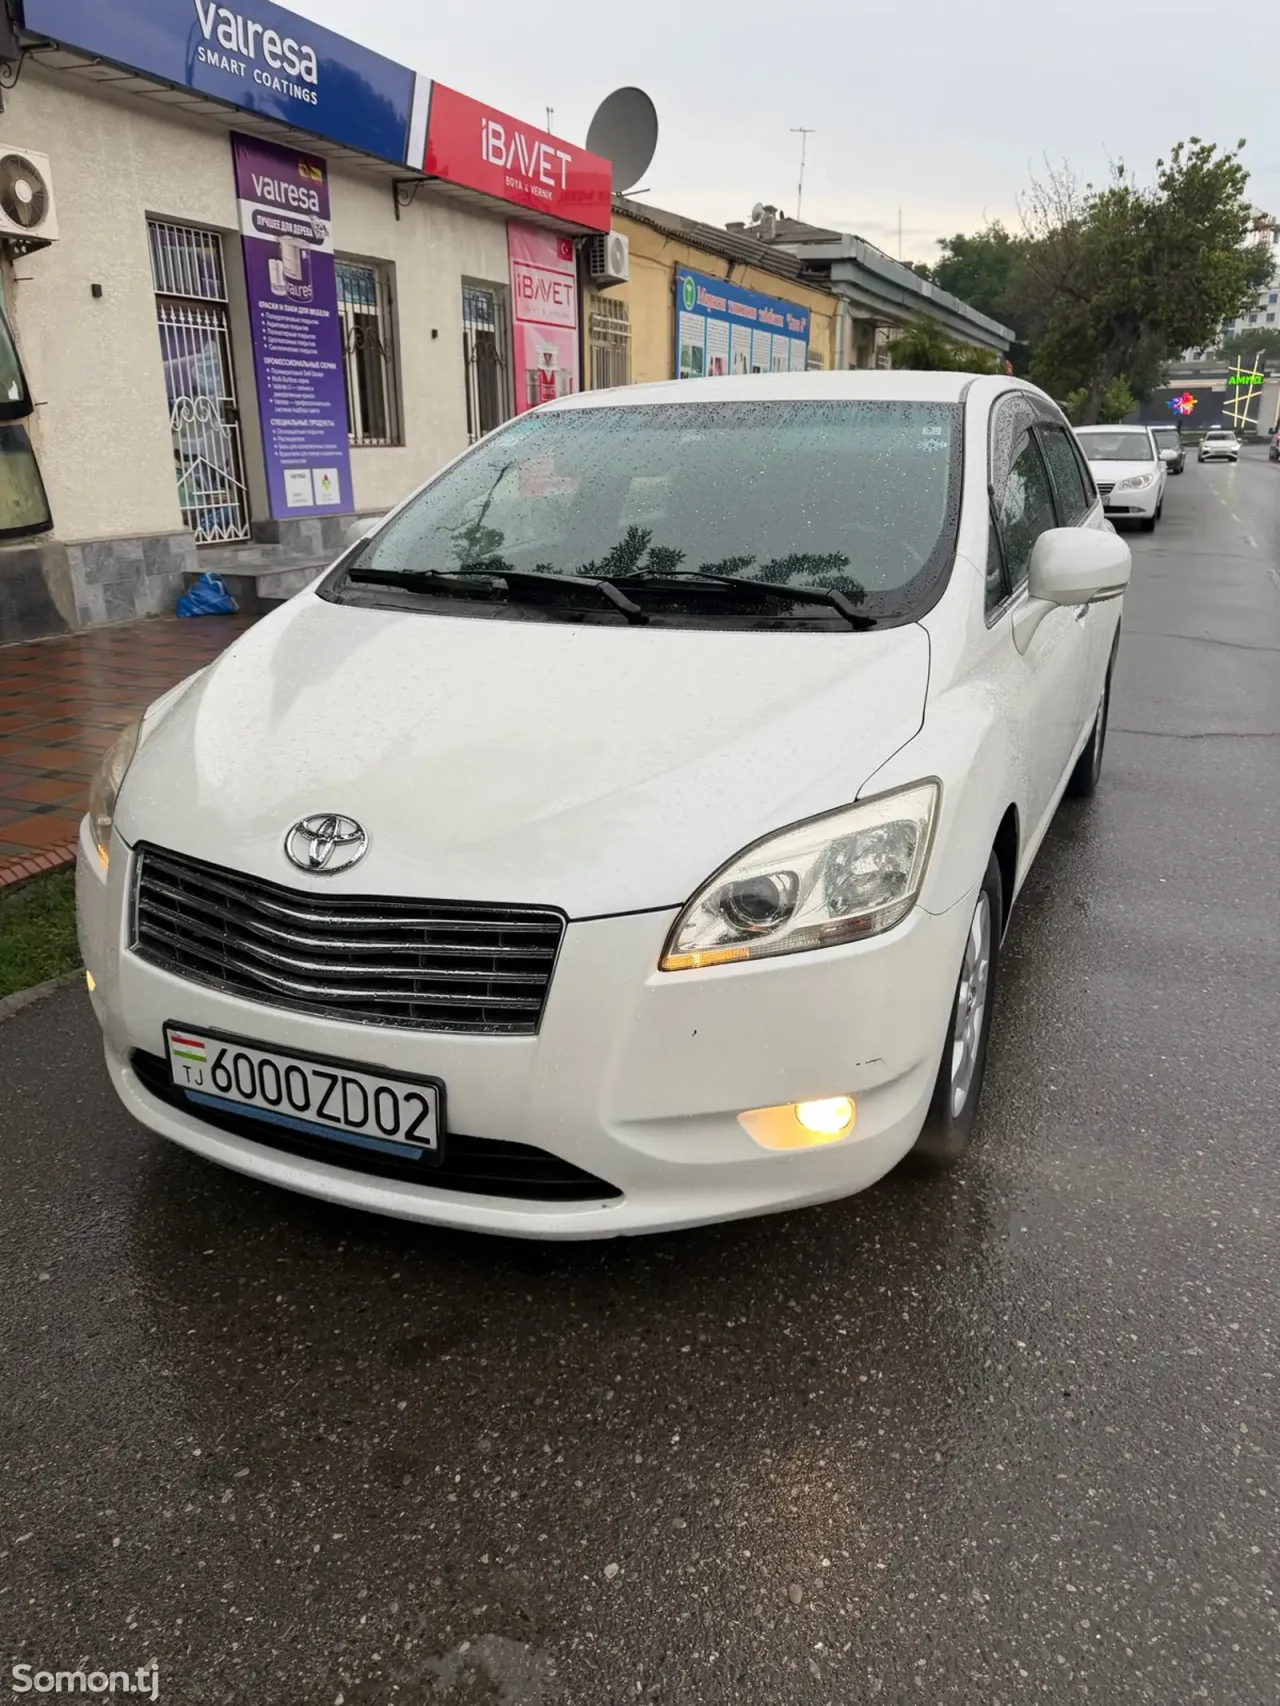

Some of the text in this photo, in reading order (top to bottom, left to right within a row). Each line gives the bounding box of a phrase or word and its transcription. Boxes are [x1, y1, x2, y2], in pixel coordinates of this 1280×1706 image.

[198, 46, 318, 105] SMART COATINGS
[505, 176, 522, 190] BOYA
[256, 215, 313, 236] ЛУЧШЕЕ ДЛЯ ДЕРЕВА
[264, 357, 320, 368] ПРОФЕССИОНАЛЬНЫЕ
[183, 1065, 204, 1086] TJ
[211, 1048, 431, 1145] 6000ZD02
